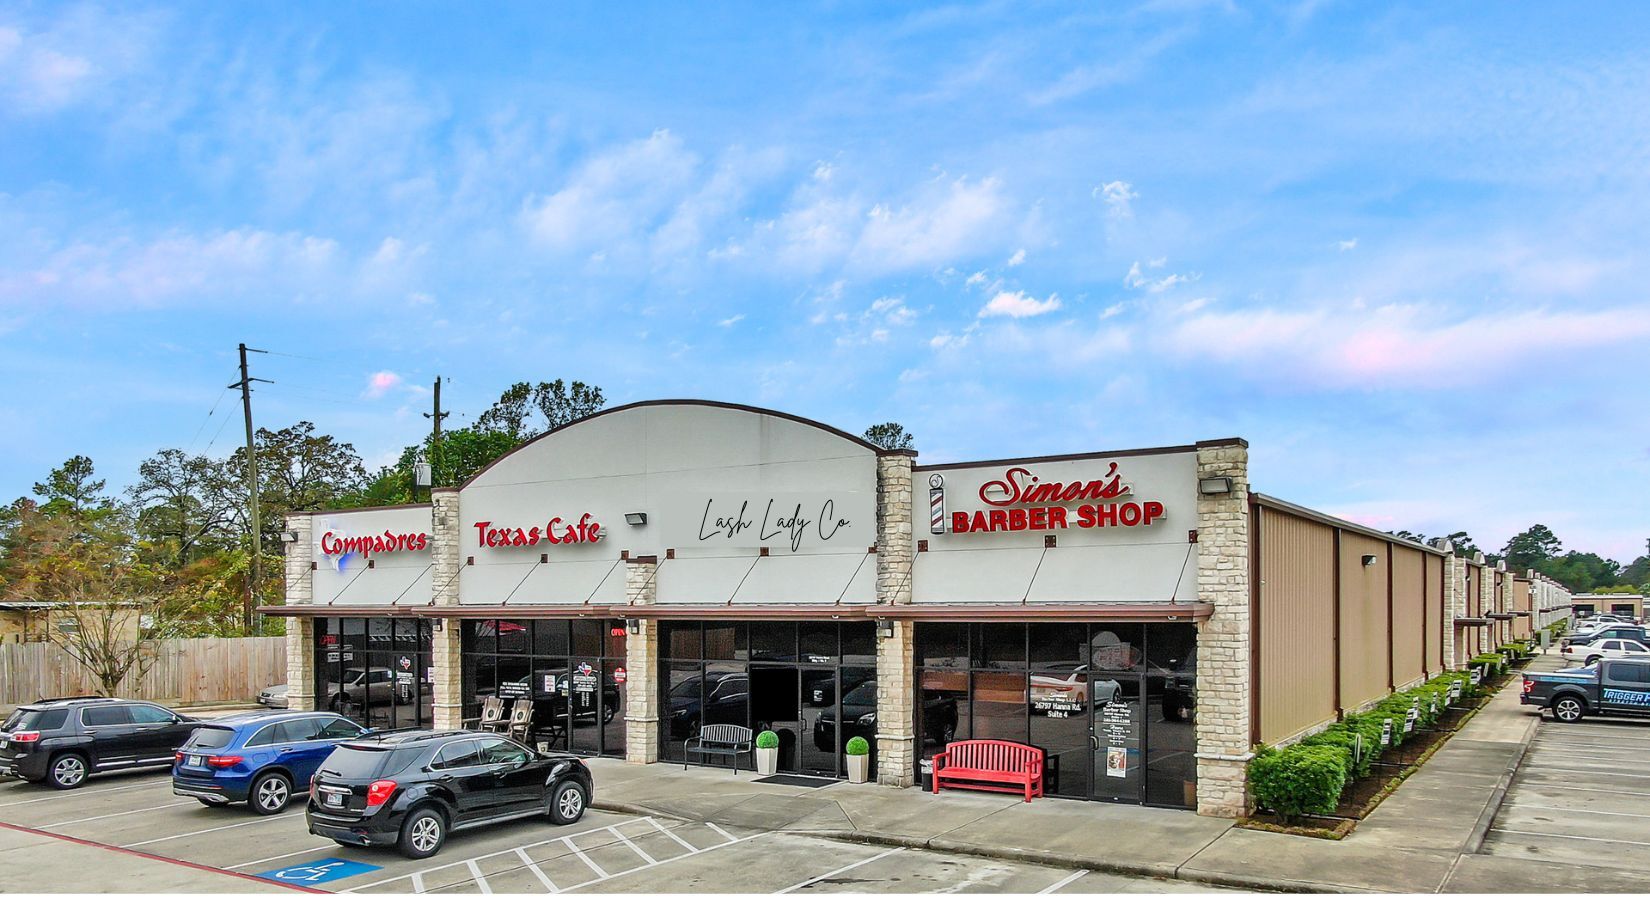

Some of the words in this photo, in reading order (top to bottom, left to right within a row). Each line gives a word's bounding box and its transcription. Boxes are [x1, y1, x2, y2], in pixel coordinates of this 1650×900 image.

[979, 462, 1129, 506] Simon's
[473, 521, 540, 548] Texas
[546, 512, 600, 544] Cafe
[699, 499, 752, 540] Lash
[760, 499, 811, 552] Lady
[818, 499, 851, 540] Co.
[952, 506, 1068, 533] BARBER
[1077, 501, 1164, 528] SHOP
[321, 529, 427, 559] Compadres
[1035, 701, 1052, 710] 26797
[1053, 702, 1071, 711] Hanna
[1603, 688, 1644, 702] TRIGGER
[1048, 710, 1063, 718] Suite
